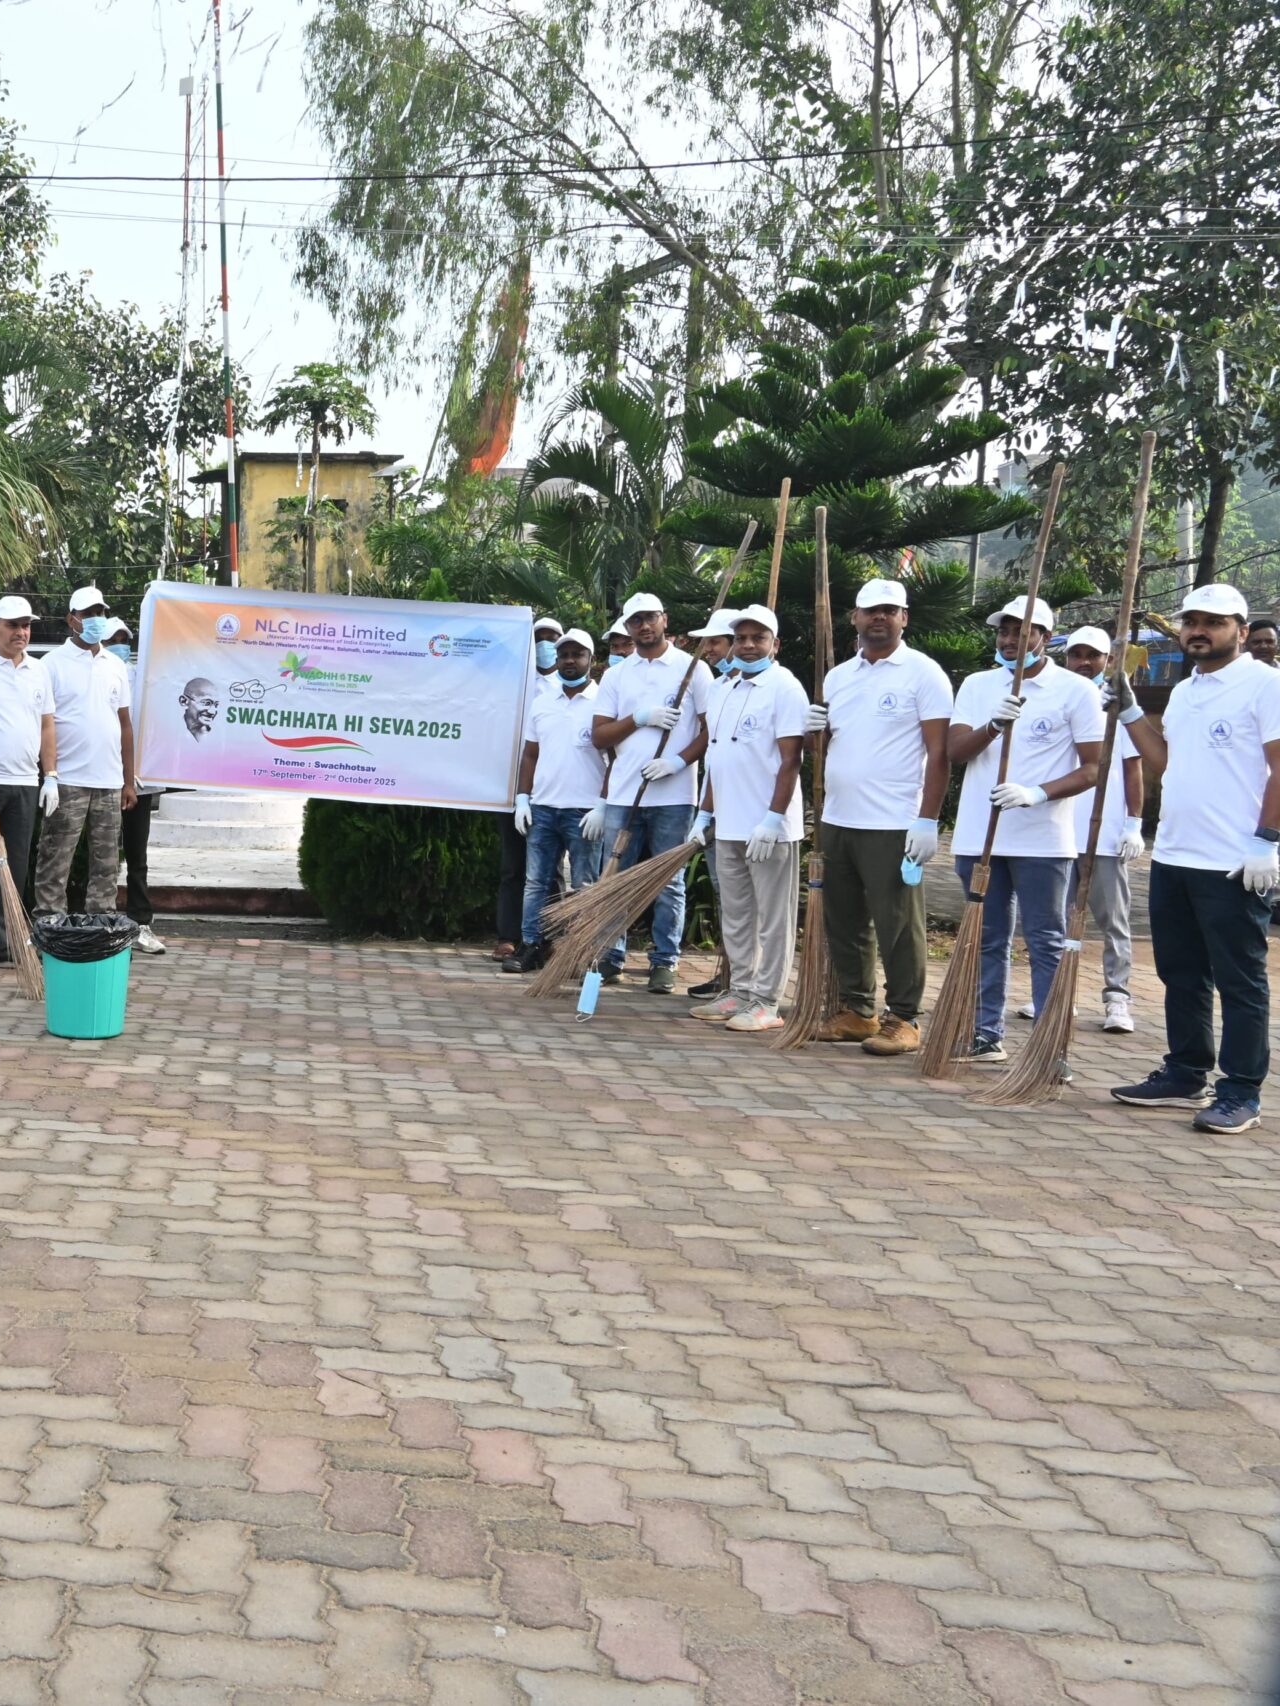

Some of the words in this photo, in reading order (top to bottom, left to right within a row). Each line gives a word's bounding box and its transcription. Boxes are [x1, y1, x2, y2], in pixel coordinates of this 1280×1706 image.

[255, 619, 290, 634] NLC
[295, 621, 336, 637] India
[342, 624, 407, 642] Limited
[299, 635, 335, 644] Government
[226, 706, 337, 731] SWACHHATA
[344, 715, 363, 733] HI
[273, 757, 305, 768] Theme
[314, 760, 377, 773] Swachhotsav
[270, 770, 316, 781] September
[324, 773, 337, 782] 2nd
[338, 775, 371, 785] October
[374, 777, 396, 786] 2025
